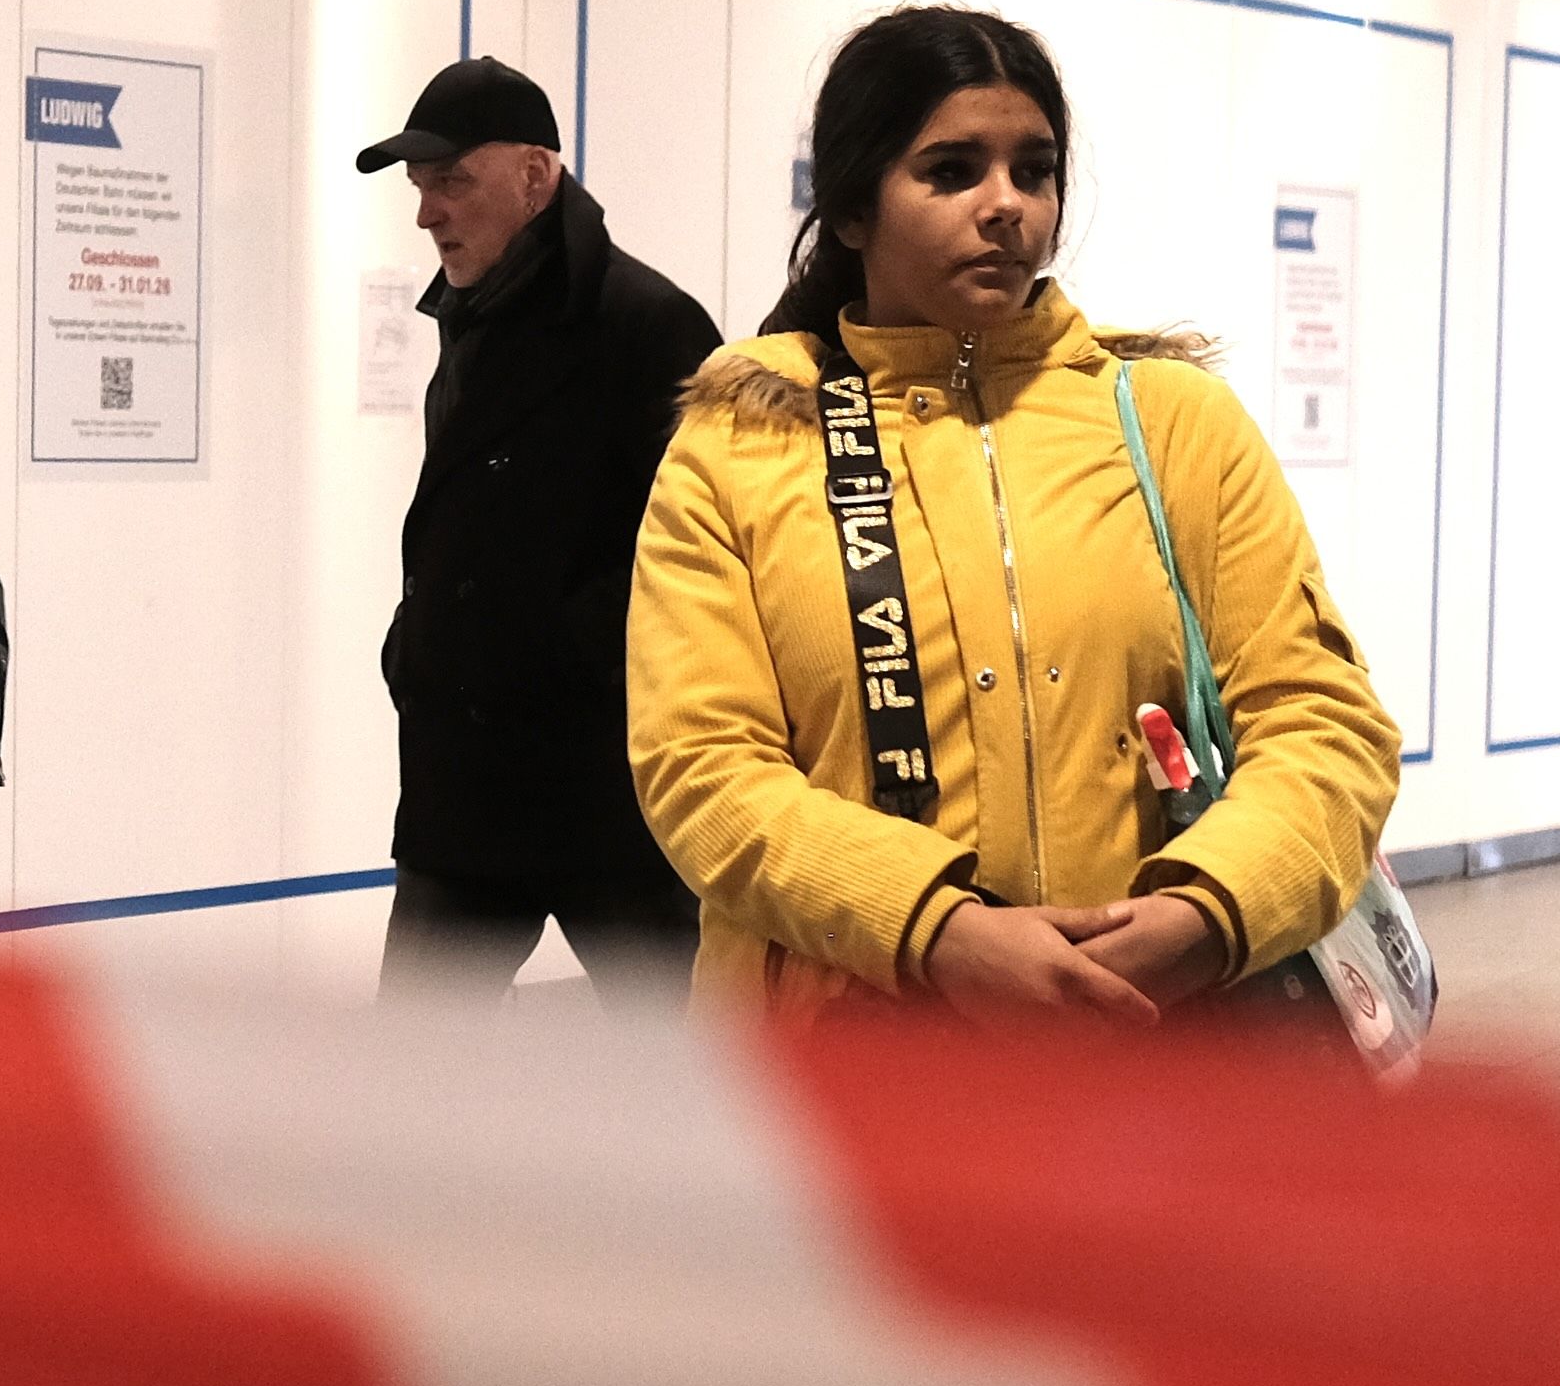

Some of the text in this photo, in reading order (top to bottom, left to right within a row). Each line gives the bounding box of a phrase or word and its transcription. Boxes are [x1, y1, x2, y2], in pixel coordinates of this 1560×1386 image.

[41, 97, 103, 129] LUDWIG
[823, 375, 876, 458] FILA
[857, 597, 915, 711] FILA
